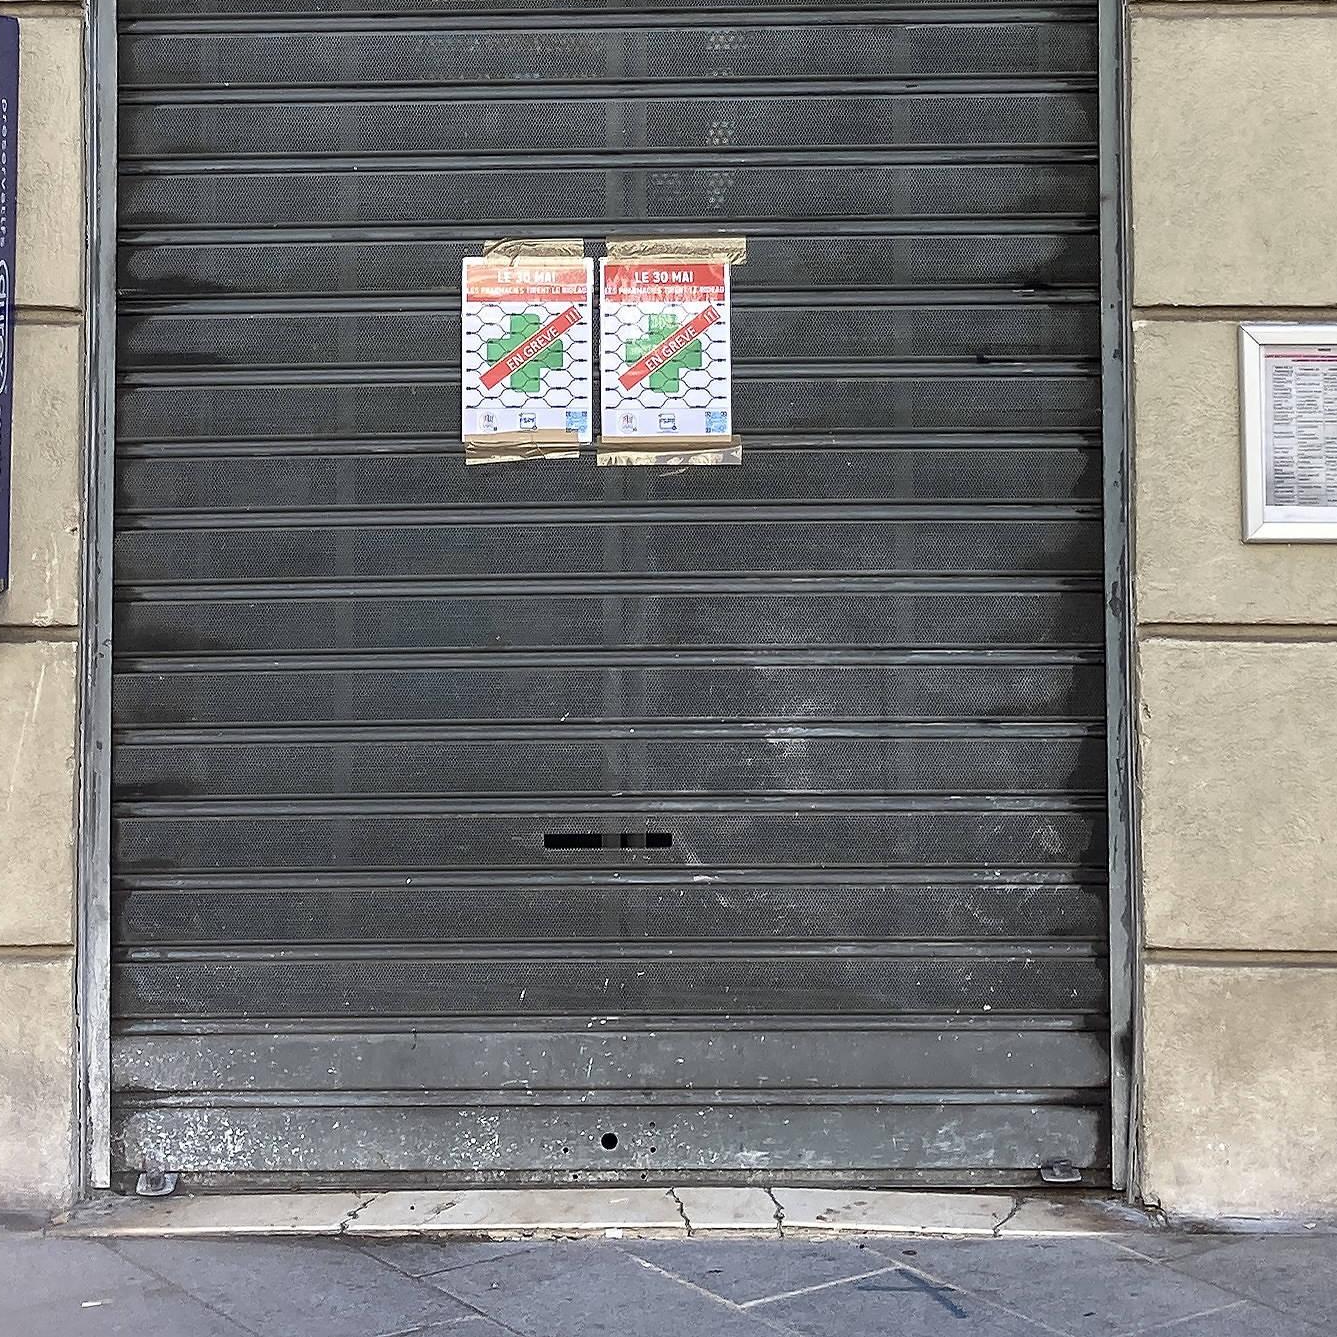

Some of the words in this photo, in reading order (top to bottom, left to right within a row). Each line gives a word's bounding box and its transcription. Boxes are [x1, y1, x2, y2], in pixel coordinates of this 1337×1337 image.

[497, 272, 512, 283] LE
[515, 272, 530, 283] 30
[534, 272, 556, 283] MAI
[634, 271, 649, 283] LE
[652, 271, 668, 283] 30
[671, 271, 694, 283] MAI
[505, 354, 523, 370] EN
[523, 325, 559, 359] GREVE
[645, 355, 662, 370] EN
[662, 325, 697, 359] GREVE
